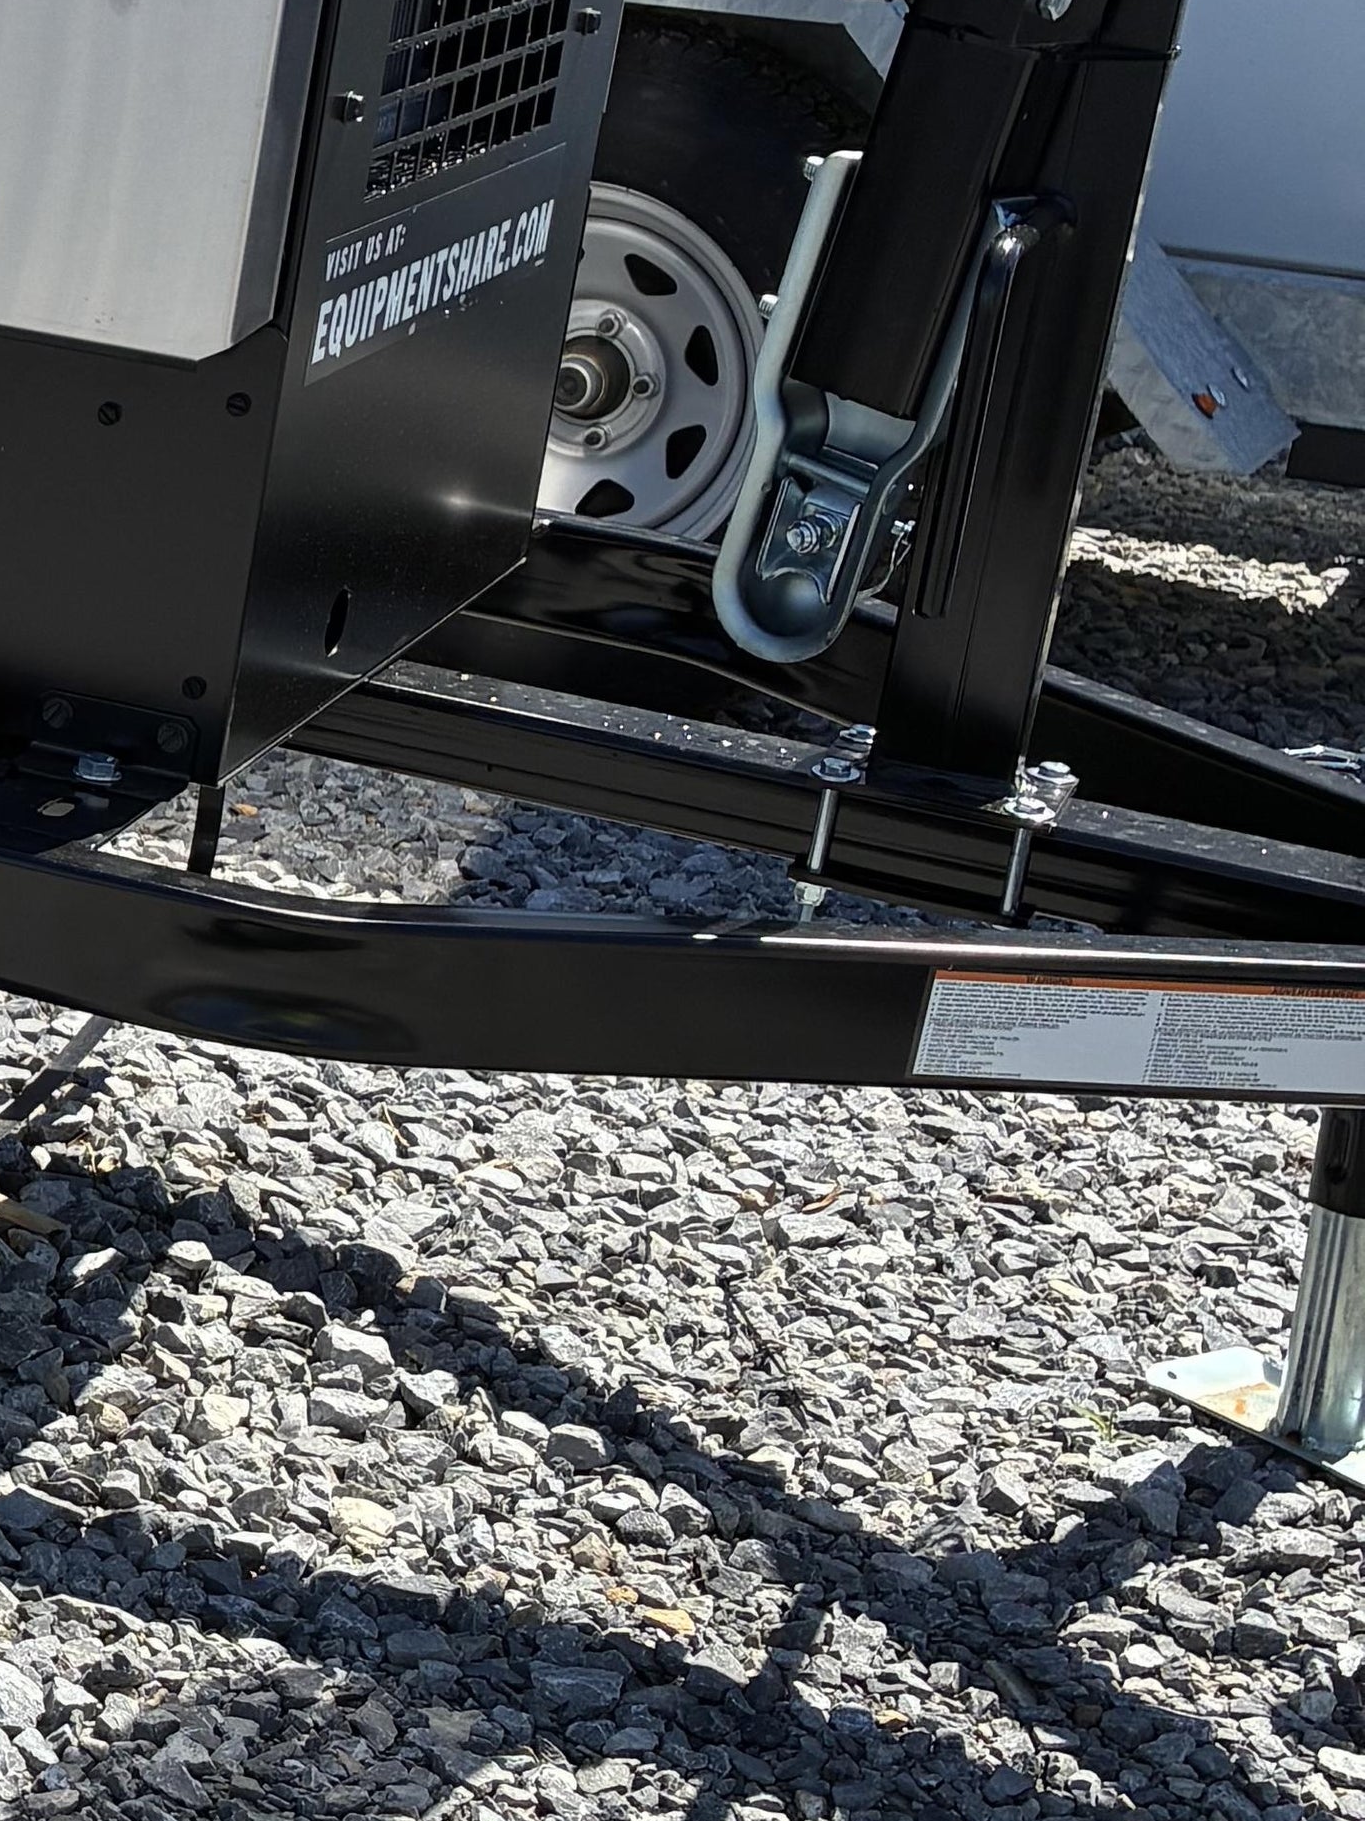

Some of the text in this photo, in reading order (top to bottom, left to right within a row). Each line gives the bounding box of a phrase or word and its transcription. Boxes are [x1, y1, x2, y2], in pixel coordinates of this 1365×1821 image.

[311, 198, 555, 365] EQUIPMENTSHARE.COM
[325, 222, 407, 283] VISIT US AT:
